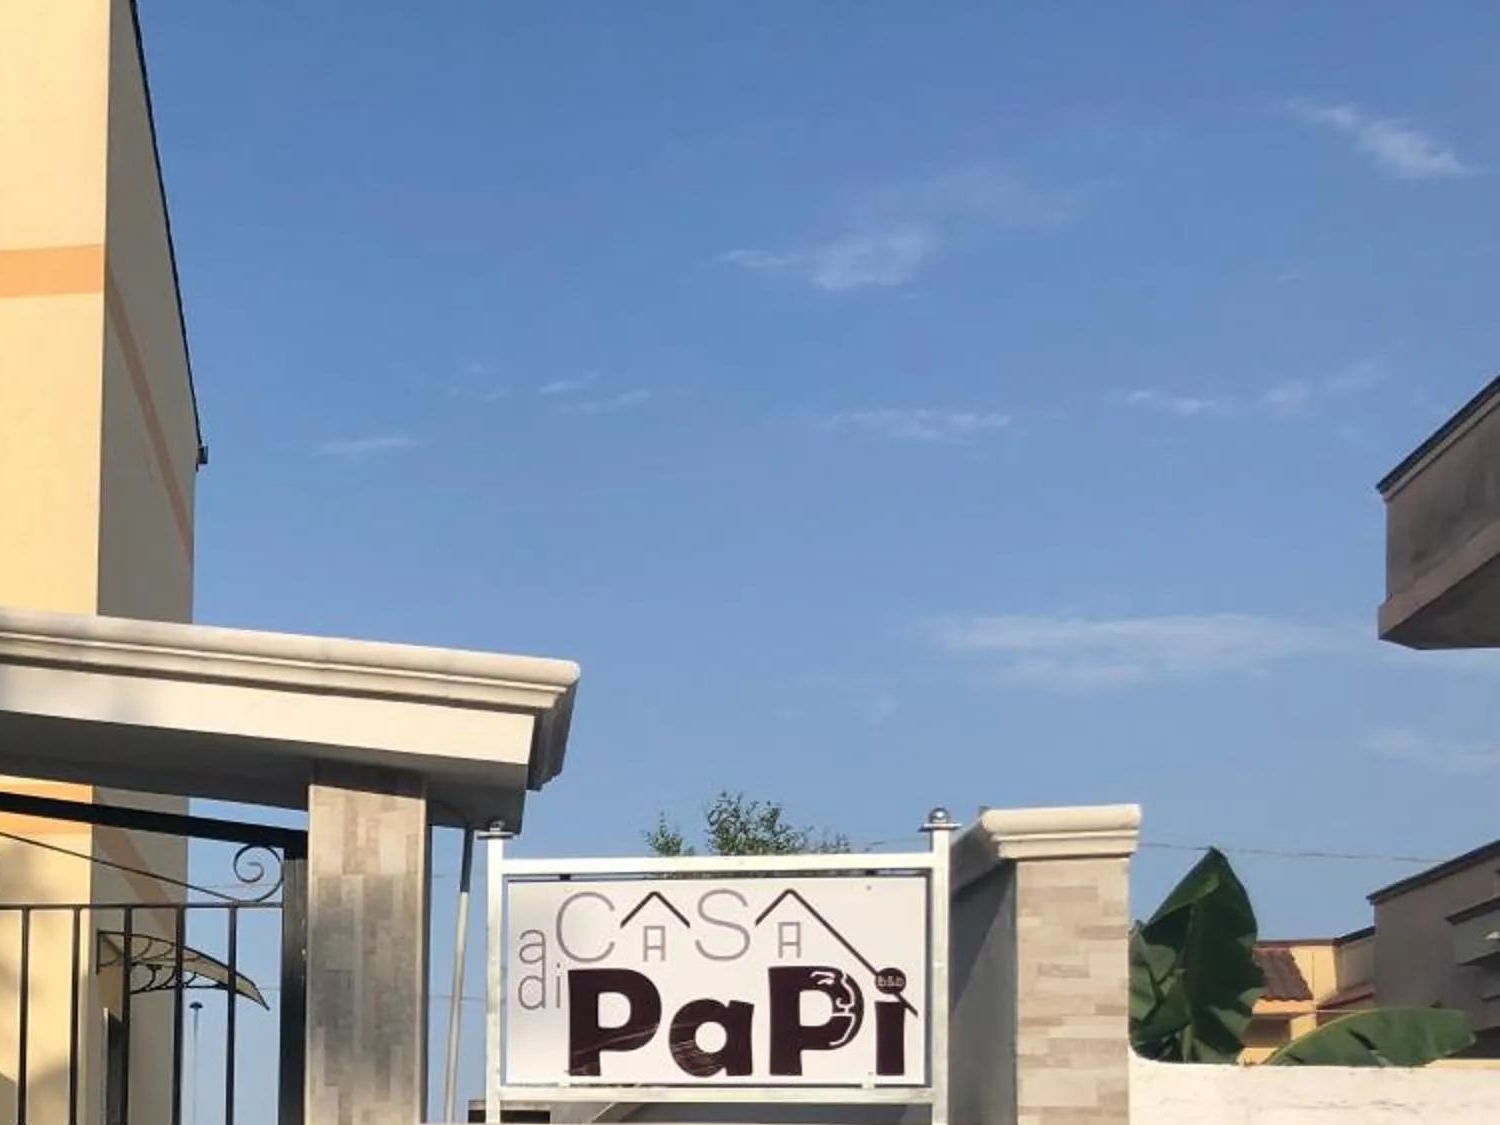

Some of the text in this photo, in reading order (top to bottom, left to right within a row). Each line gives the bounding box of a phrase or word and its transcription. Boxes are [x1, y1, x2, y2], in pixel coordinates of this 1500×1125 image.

[518, 888, 835, 965] a CASA
[517, 961, 907, 1077] di PaPi
